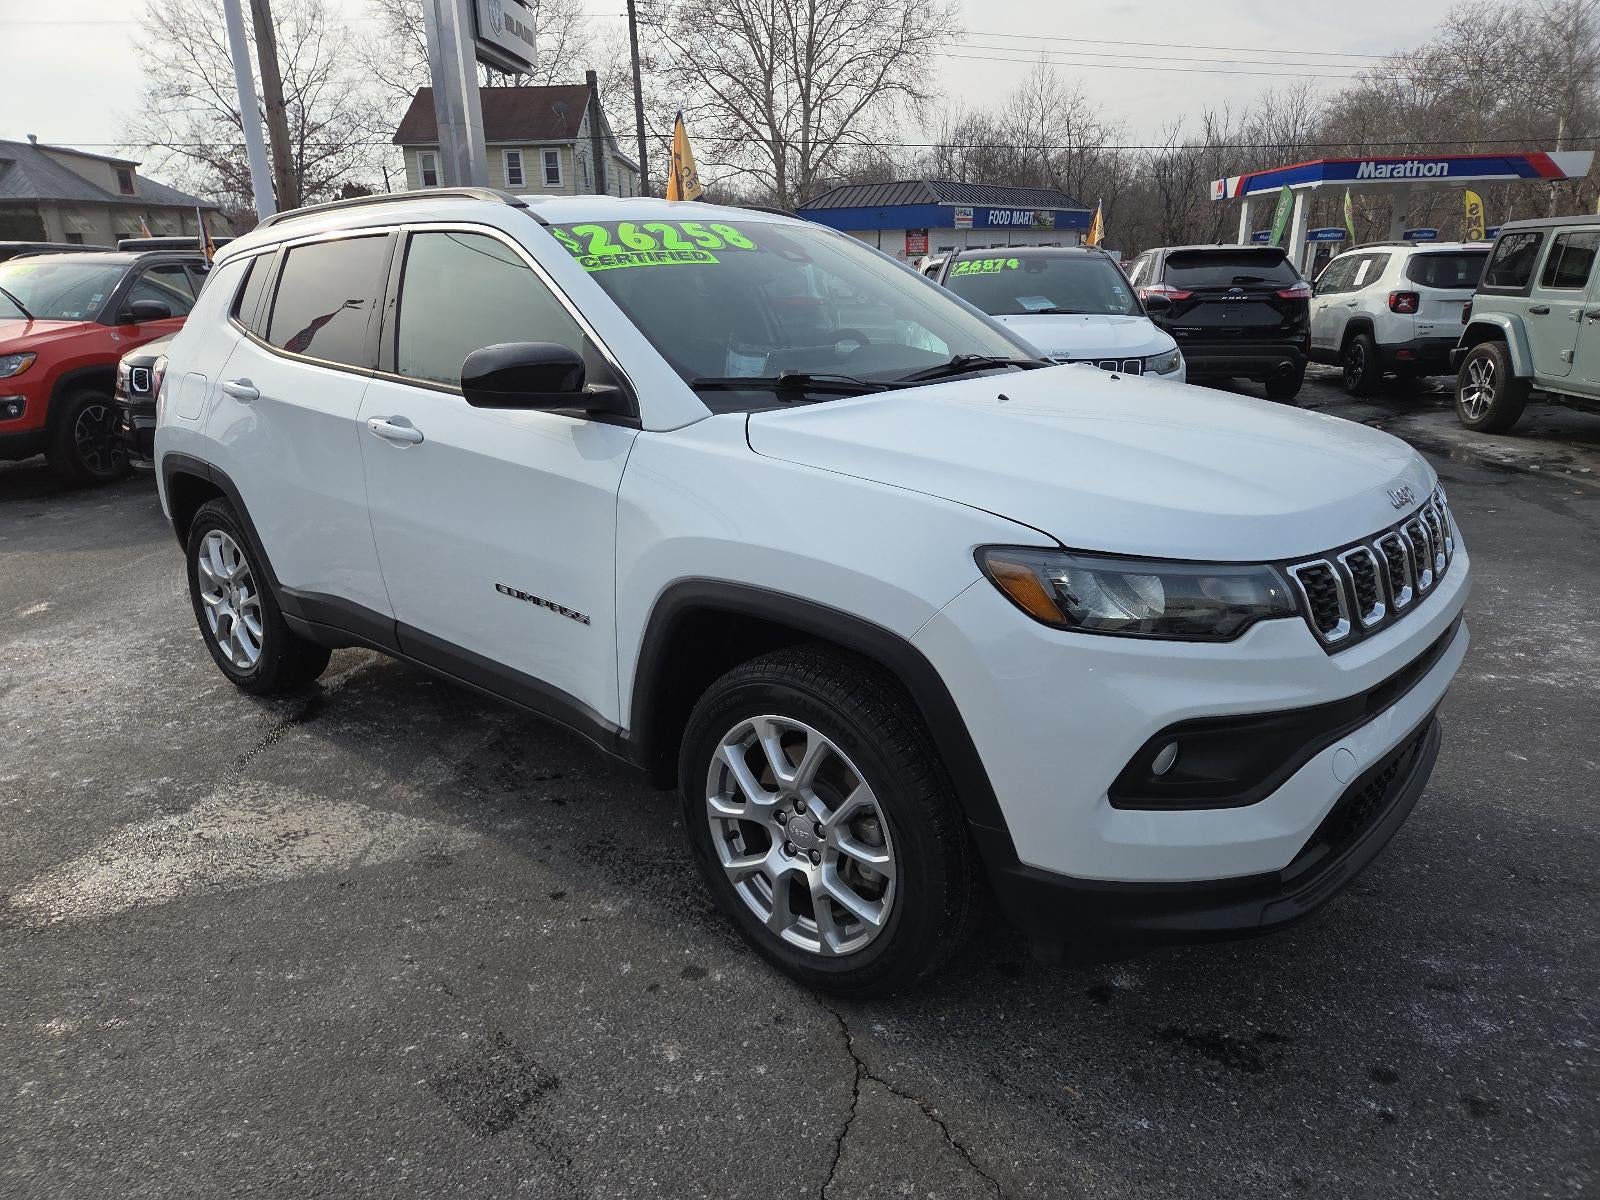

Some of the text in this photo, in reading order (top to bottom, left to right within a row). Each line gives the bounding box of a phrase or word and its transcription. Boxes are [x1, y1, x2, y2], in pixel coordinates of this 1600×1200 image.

[1356, 160, 1449, 179] Marathon
[988, 210, 1035, 225] FOOD MART
[553, 223, 756, 254] $26258
[579, 250, 712, 268] CERTIFIED
[1387, 486, 1415, 510] Jeep
[495, 583, 591, 625] COMPASS
